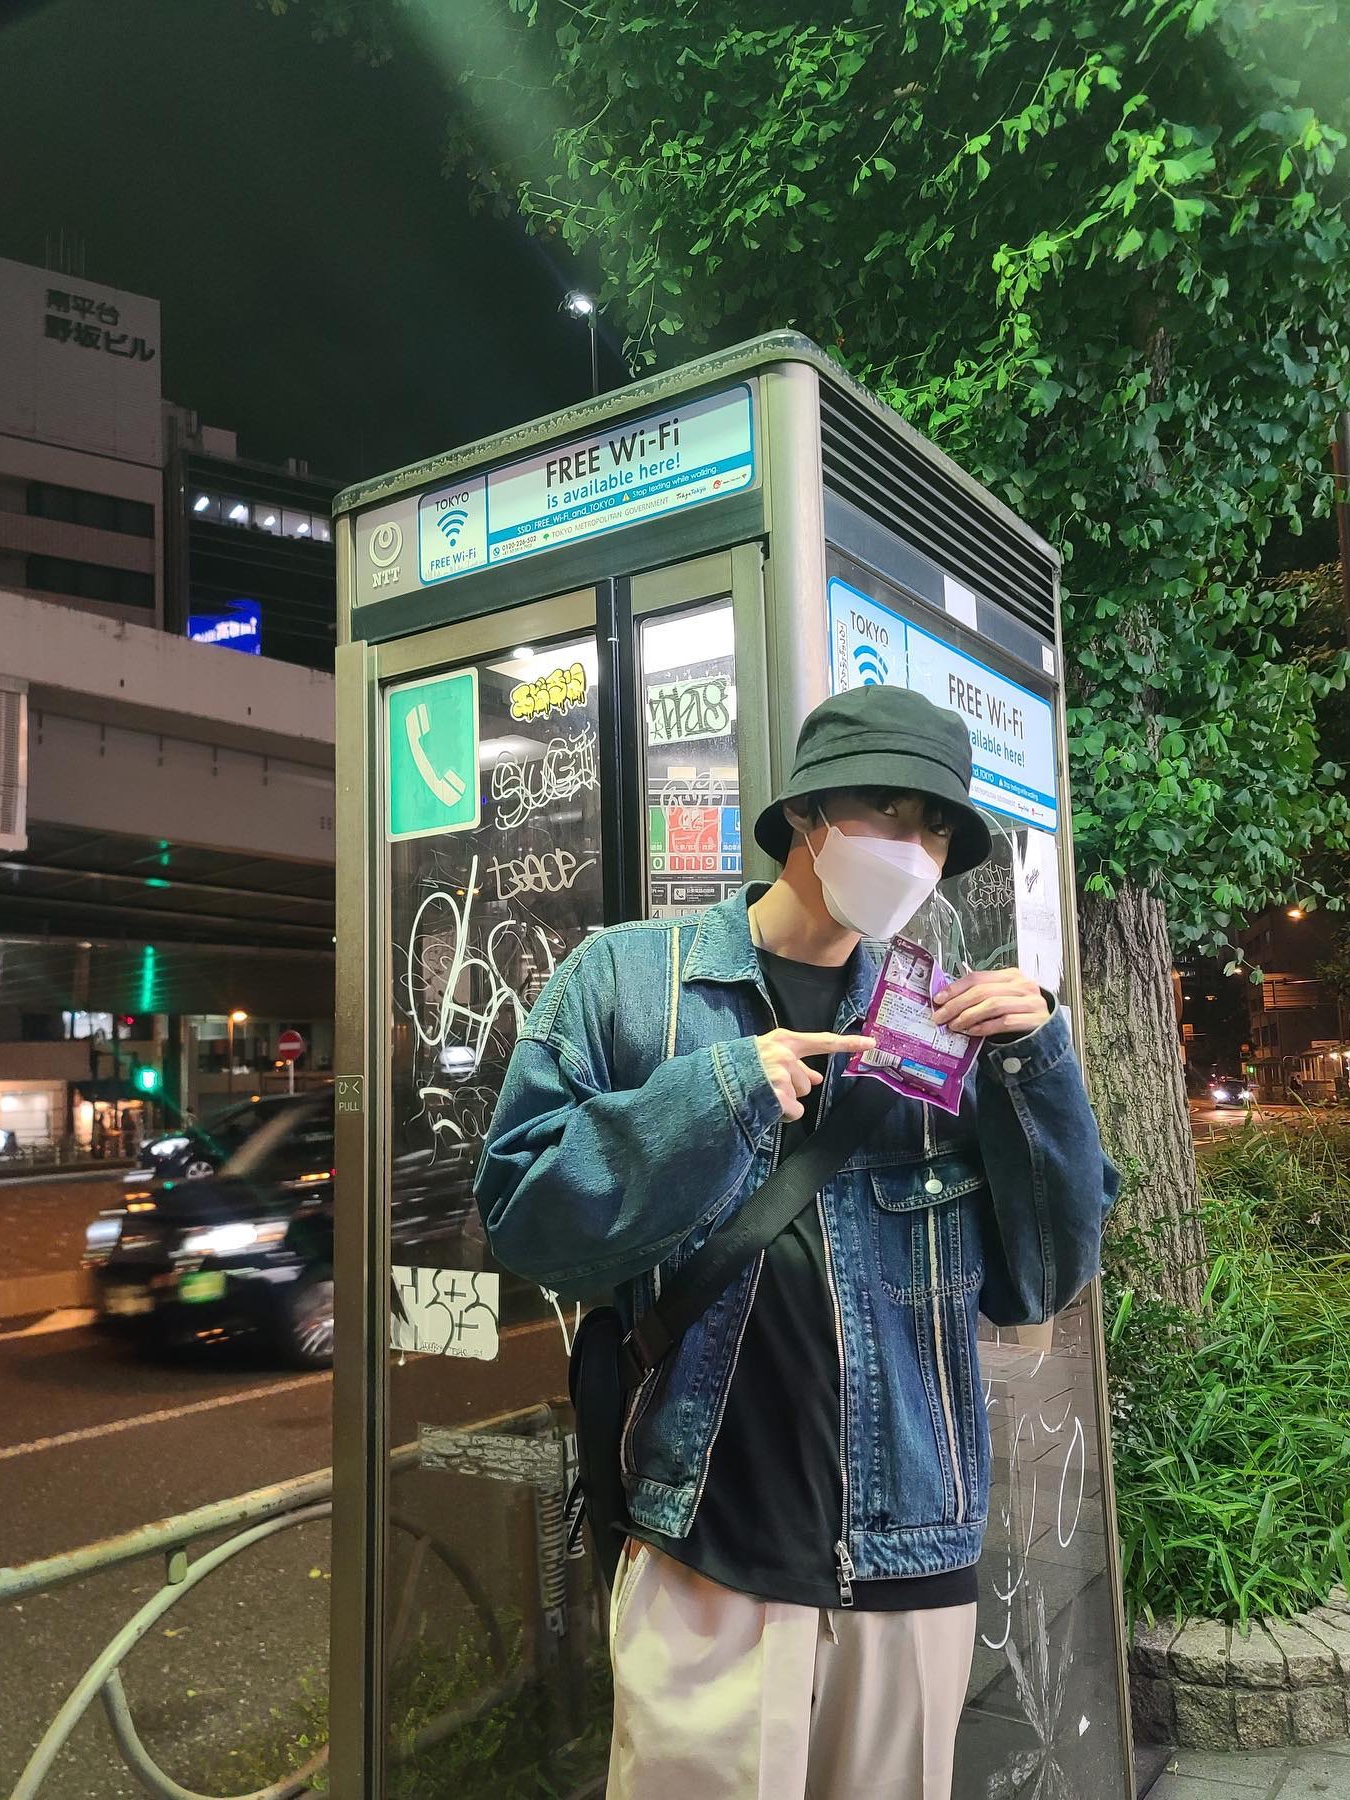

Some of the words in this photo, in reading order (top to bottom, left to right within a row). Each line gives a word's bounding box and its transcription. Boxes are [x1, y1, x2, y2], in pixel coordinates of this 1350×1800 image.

[44, 313, 155, 362] 野坂ビル
[546, 445, 601, 488] FREE
[609, 418, 679, 466] Wi-Fi
[547, 494, 558, 509] is
[563, 470, 634, 503] available
[639, 452, 680, 480] here!
[632, 488, 648, 498] Stop
[648, 480, 671, 493] texting
[672, 475, 690, 485] while
[435, 491, 470, 512] TOKYO
[552, 526, 573, 538] TOKYO
[574, 511, 622, 532] METROPOLITAN
[624, 497, 669, 516] GOVERNMENT
[430, 556, 451, 571] FREE
[453, 547, 476, 564] Wi-Fi
[372, 567, 401, 589] NTT
[850, 610, 889, 647] TOKYO
[949, 673, 983, 720] FREE
[986, 693, 1024, 740] Wi-Fi
[1004, 741, 1025, 768] here!
[338, 1080, 361, 1095] ひく
[338, 1101, 361, 1111] PULL
